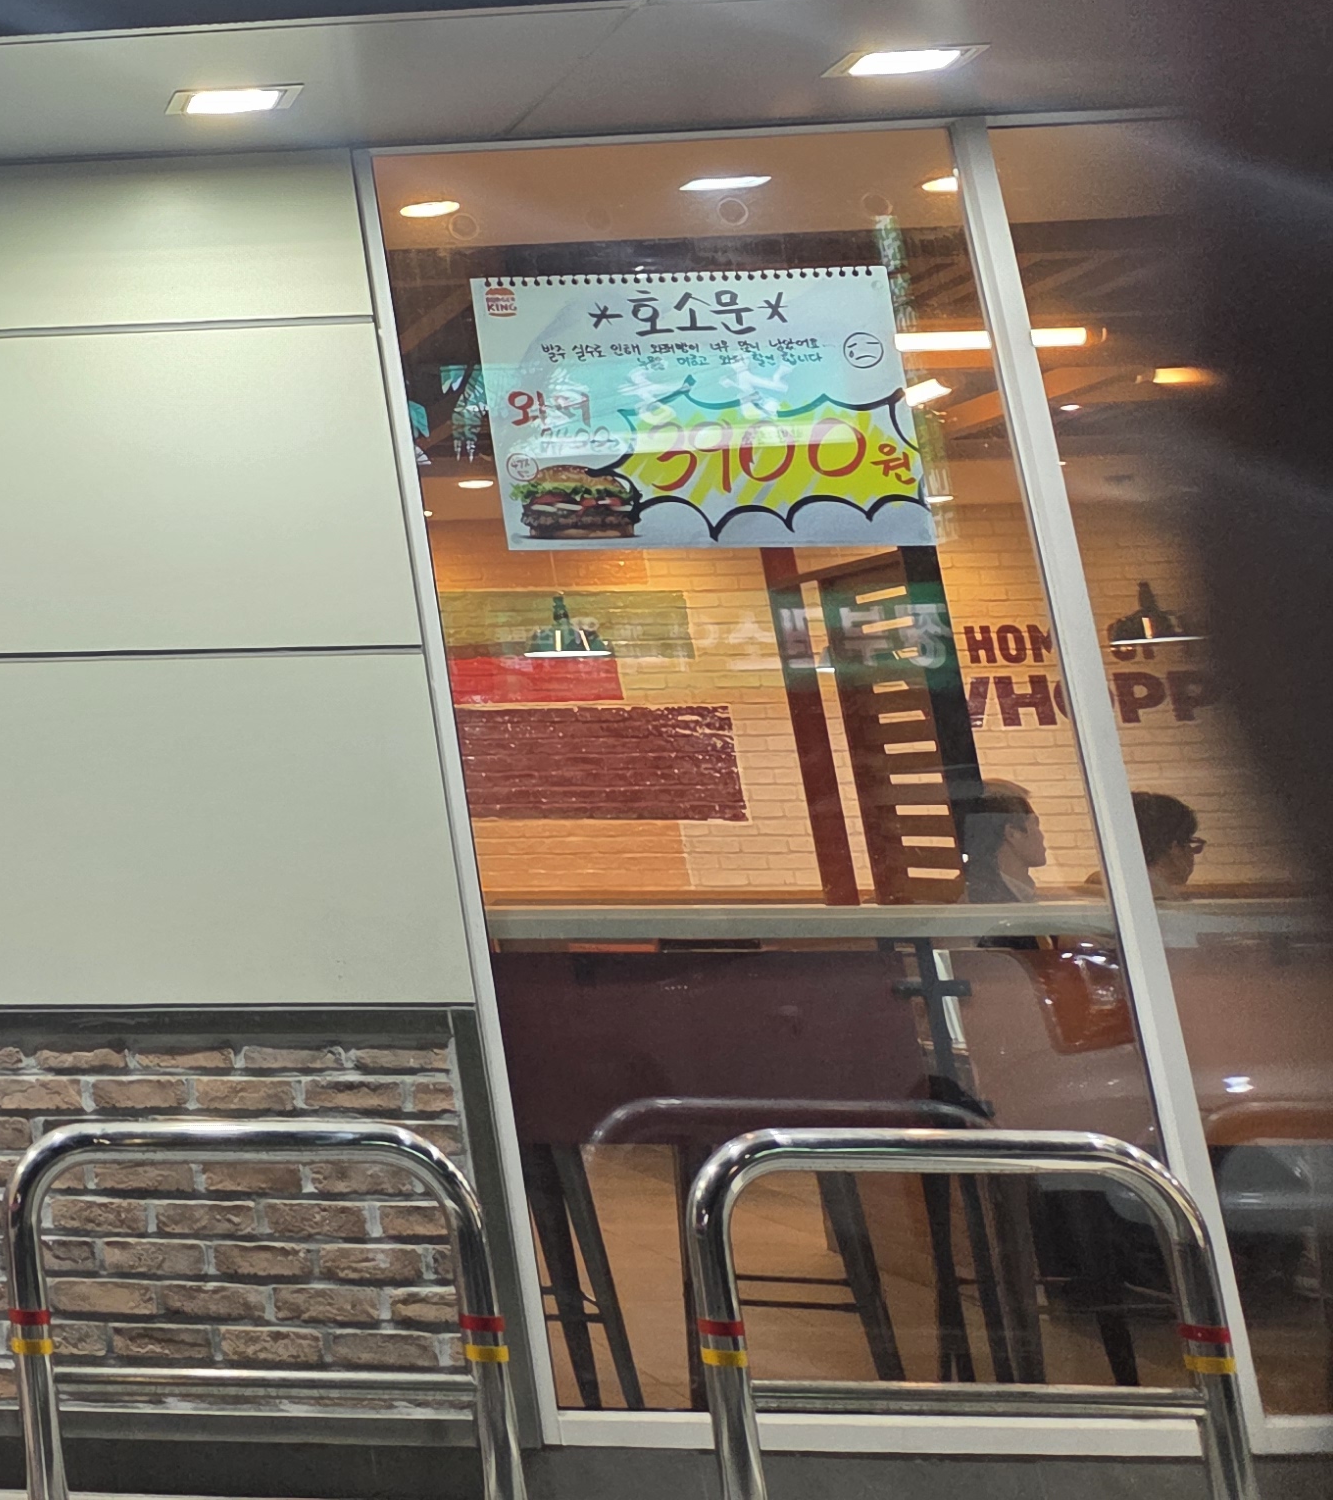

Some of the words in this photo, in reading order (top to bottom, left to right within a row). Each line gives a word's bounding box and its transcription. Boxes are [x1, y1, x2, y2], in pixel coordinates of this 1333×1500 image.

[487, 303, 517, 312] KING
[627, 290, 757, 337] 호소문
[610, 343, 641, 356] 인해
[648, 417, 916, 493] 3900원
[963, 624, 1053, 664] HOM
